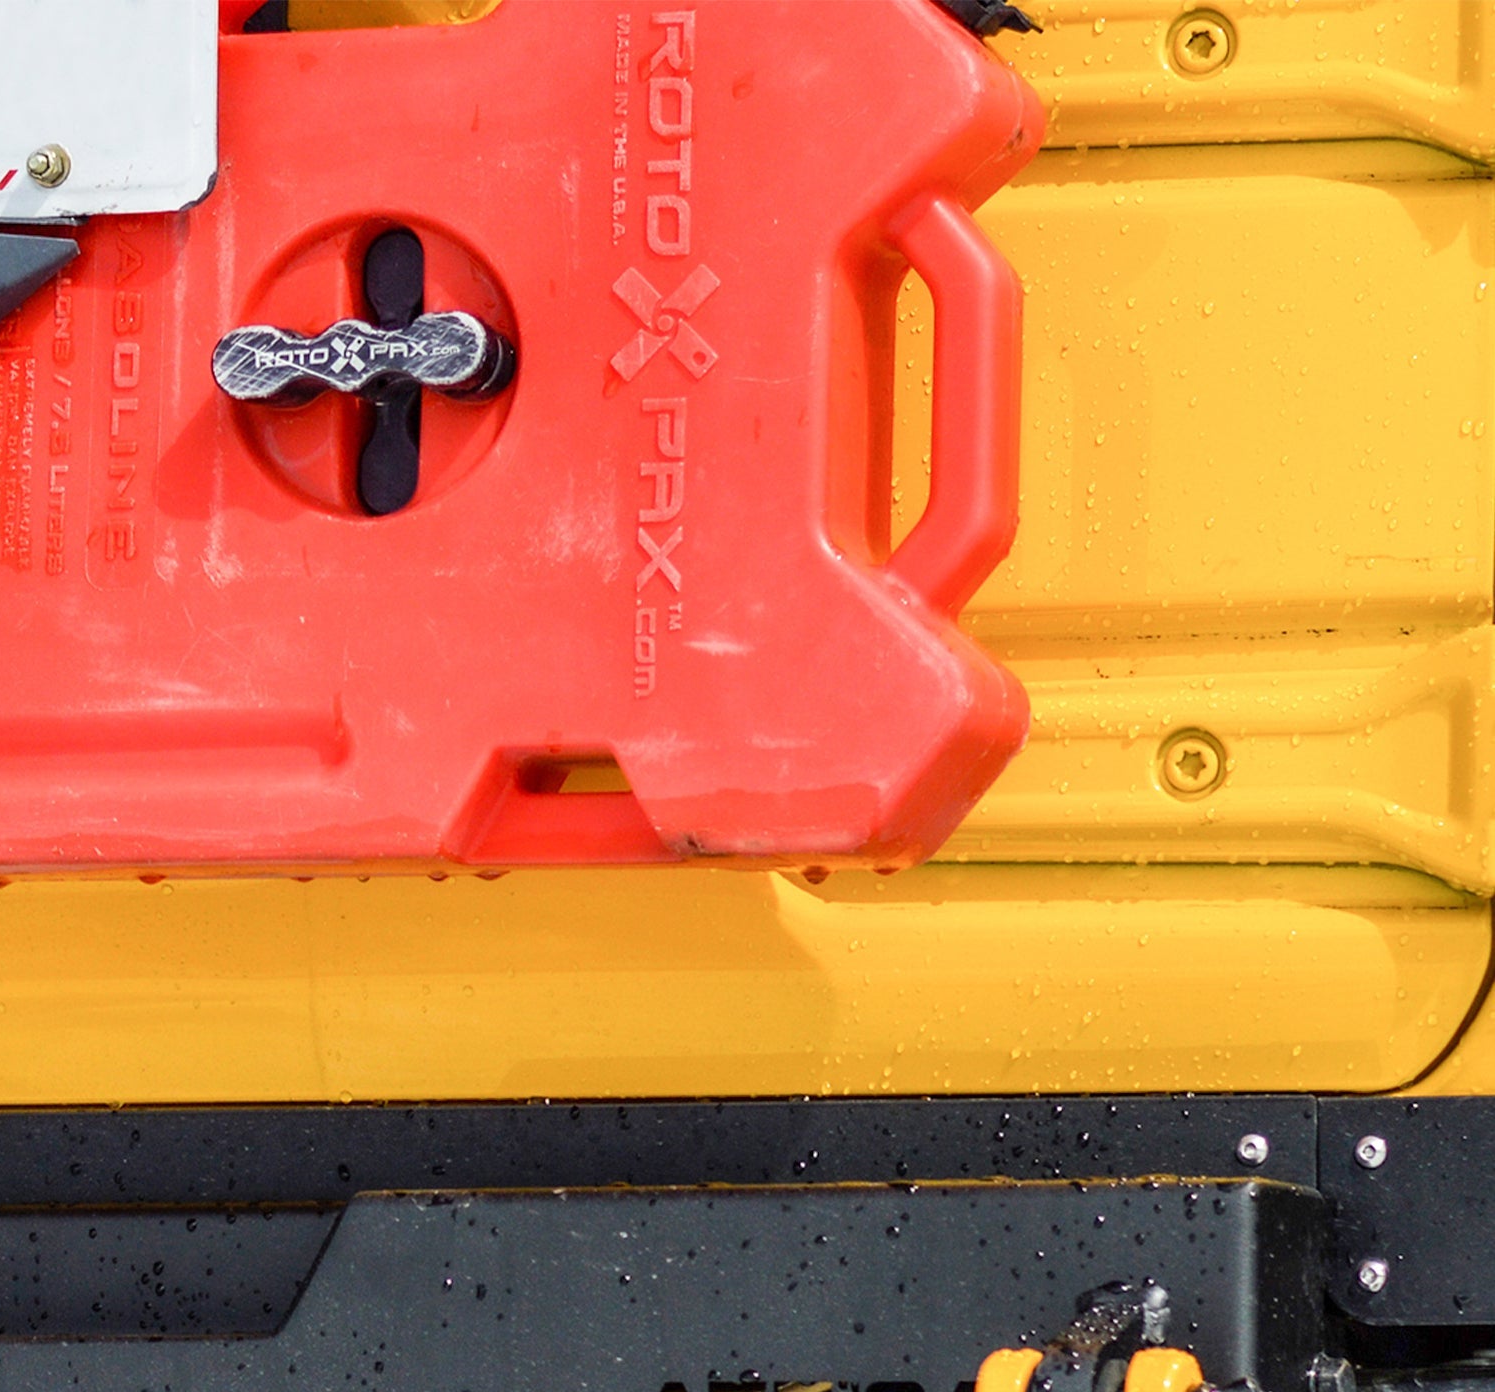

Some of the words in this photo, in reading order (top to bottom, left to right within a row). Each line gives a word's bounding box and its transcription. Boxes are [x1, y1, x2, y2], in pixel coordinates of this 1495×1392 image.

[614, 12, 631, 85] MADE
[613, 91, 630, 116] IN
[639, 10, 696, 256] ROTO
[612, 122, 629, 170] THE
[611, 177, 628, 248] U.S.A.
[53, 278, 74, 365] LONS
[255, 347, 328, 369] ROTO
[46, 464, 70, 575] LITERS
